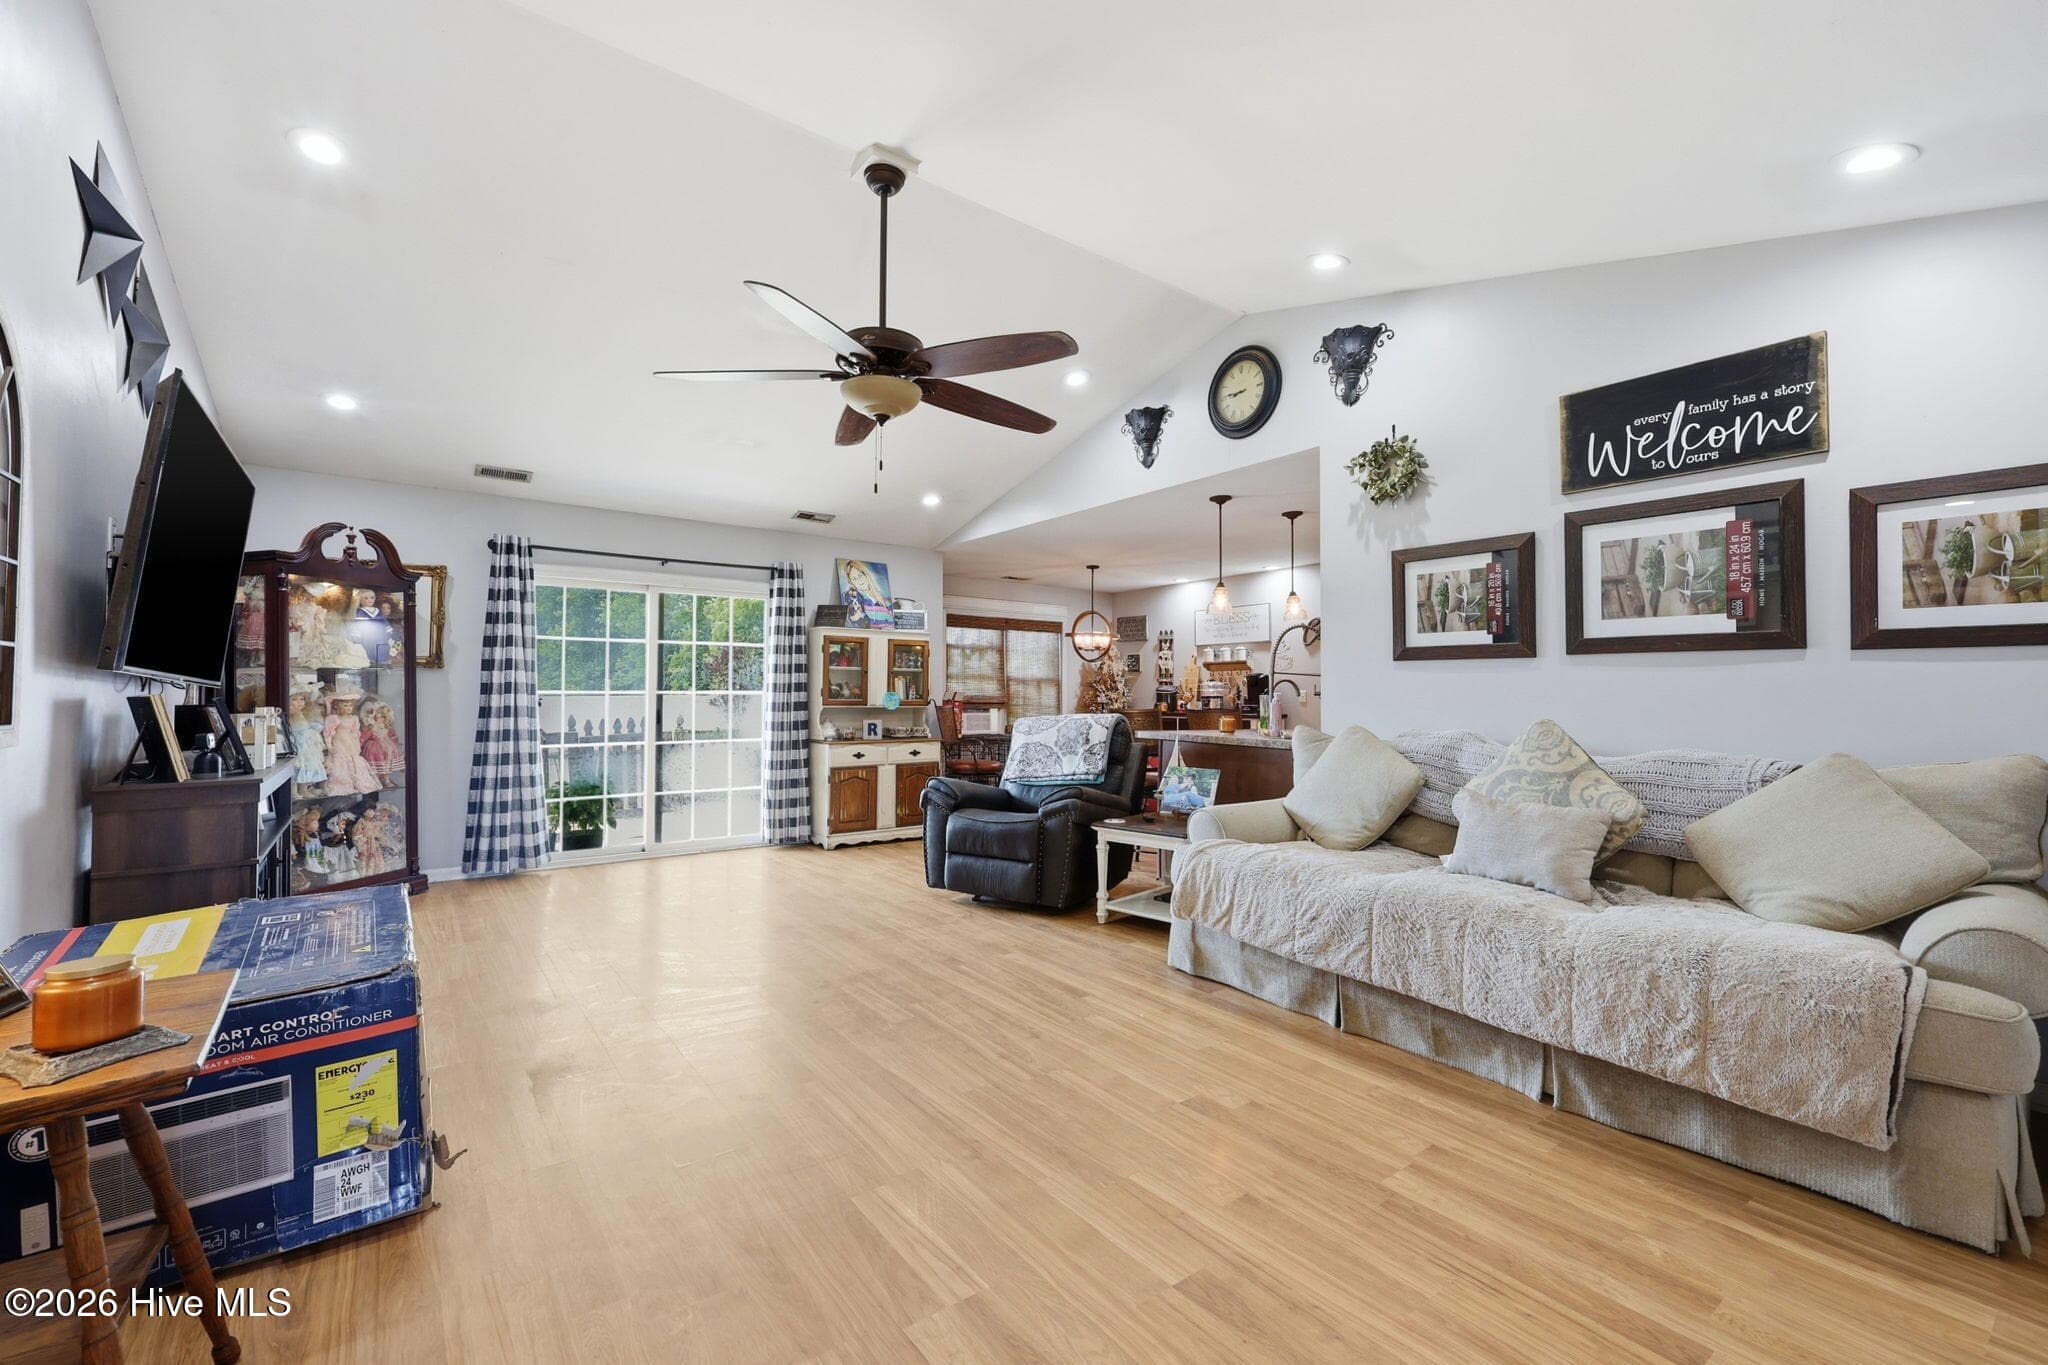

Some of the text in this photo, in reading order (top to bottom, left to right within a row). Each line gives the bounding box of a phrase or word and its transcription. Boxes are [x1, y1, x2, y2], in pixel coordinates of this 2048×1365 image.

[1633, 380, 1816, 426] every family has a story
[1651, 450, 1719, 470] to ours
[1743, 521, 1752, 534] cm
[1729, 535, 1740, 543] in
[1729, 544, 1740, 554] 24
[1729, 562, 1740, 571] in
[1743, 561, 1752, 574] cm
[1729, 571, 1740, 581] 18
[1741, 576, 1752, 593] 45.7
[867, 723, 878, 736] R
[206, 1009, 392, 1057] OOM AIR CONDITIONER
[211, 1010, 343, 1044] ART CONTROL
[232, 1054, 256, 1064] COOL
[350, 1089, 375, 1100] $230
[341, 1162, 370, 1178] AWGH
[341, 1178, 352, 1188] 24
[341, 1183, 363, 1198] WWF
